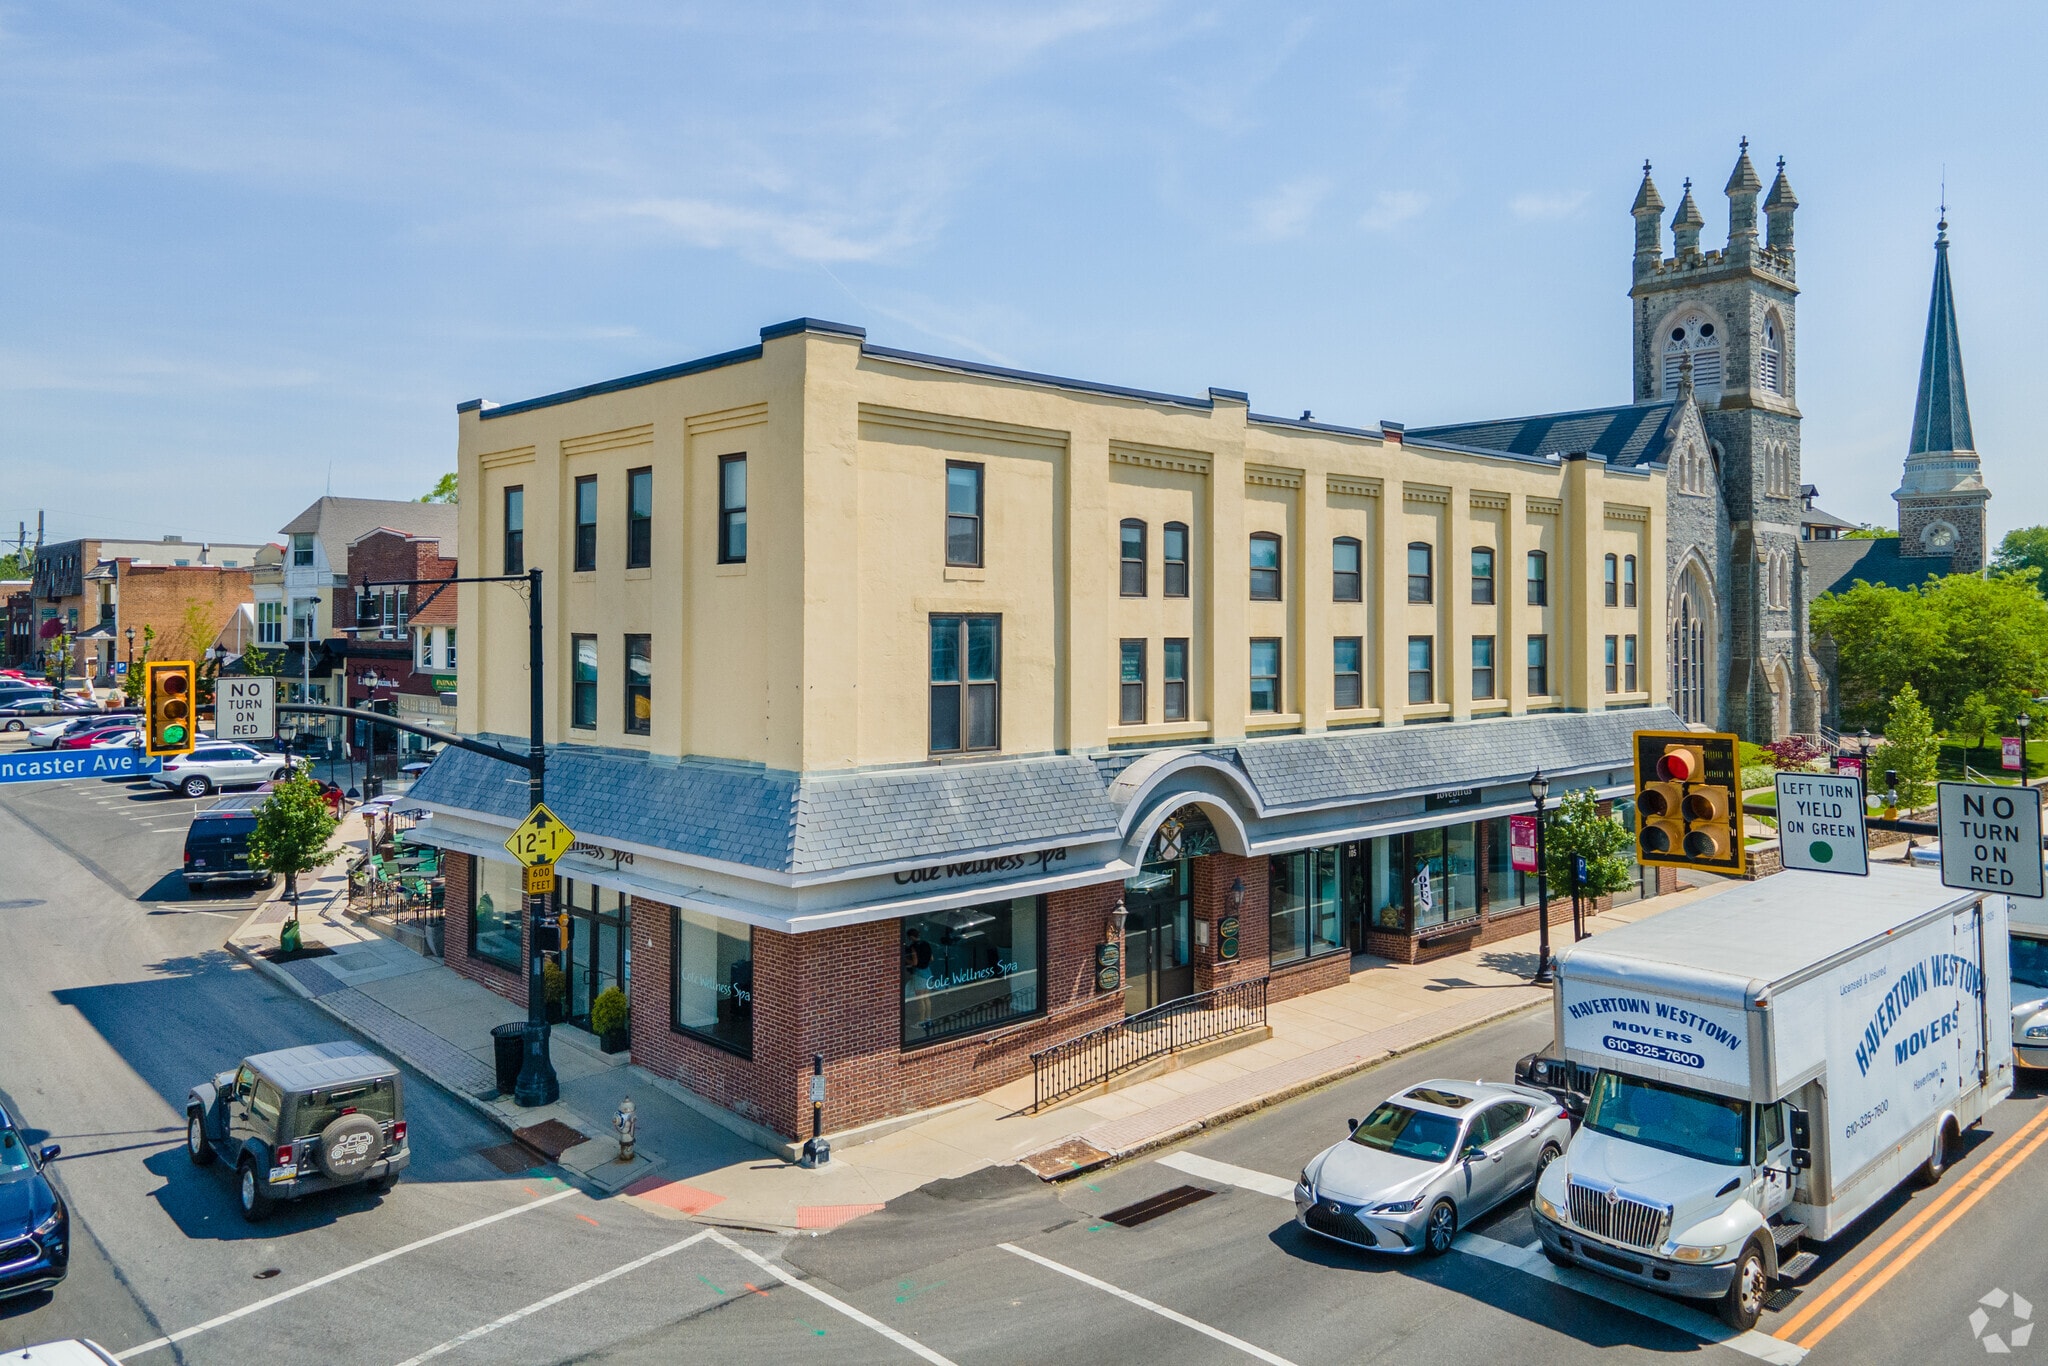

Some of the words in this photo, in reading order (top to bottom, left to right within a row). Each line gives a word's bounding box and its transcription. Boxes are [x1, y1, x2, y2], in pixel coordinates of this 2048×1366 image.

[231, 683, 260, 697] NO
[228, 699, 262, 710] TURN
[236, 711, 255, 722] ON
[232, 724, 258, 735] RED
[93, 754, 133, 771] Ave
[1782, 782, 1813, 796] LEFT
[1818, 784, 1853, 799] TURN
[1796, 800, 1842, 819] YIELD
[1963, 793, 2015, 819] NO
[1787, 820, 1805, 834] ON
[1812, 822, 1856, 838] GREEN
[1959, 821, 2019, 843] TURN
[1974, 844, 2007, 864] ON
[532, 867, 550, 878] 600
[894, 866, 941, 885] Cole
[946, 853, 1025, 878] Wellness
[1028, 846, 1067, 872] Spa
[1970, 865, 2014, 886] RED
[531, 879, 551, 891] FEET
[926, 974, 950, 990] Cole
[952, 966, 995, 985] Wellness
[997, 959, 1018, 980] Spa
[700, 973, 732, 996] Wellness
[733, 982, 751, 1007] Spa
[1840, 975, 1863, 996] Licensed
[1567, 997, 1650, 1020] HAVERTOWN
[1655, 1002, 1742, 1051] WESTTOWN
[1855, 959, 1928, 1078] HAVERTOWN
[1612, 1020, 1693, 1044] MOVERS
[1894, 1007, 1959, 1067] MOVERS
[1607, 1038, 1700, 1067] 610-325-7600
[1845, 1098, 1889, 1139] 610-325-7600
